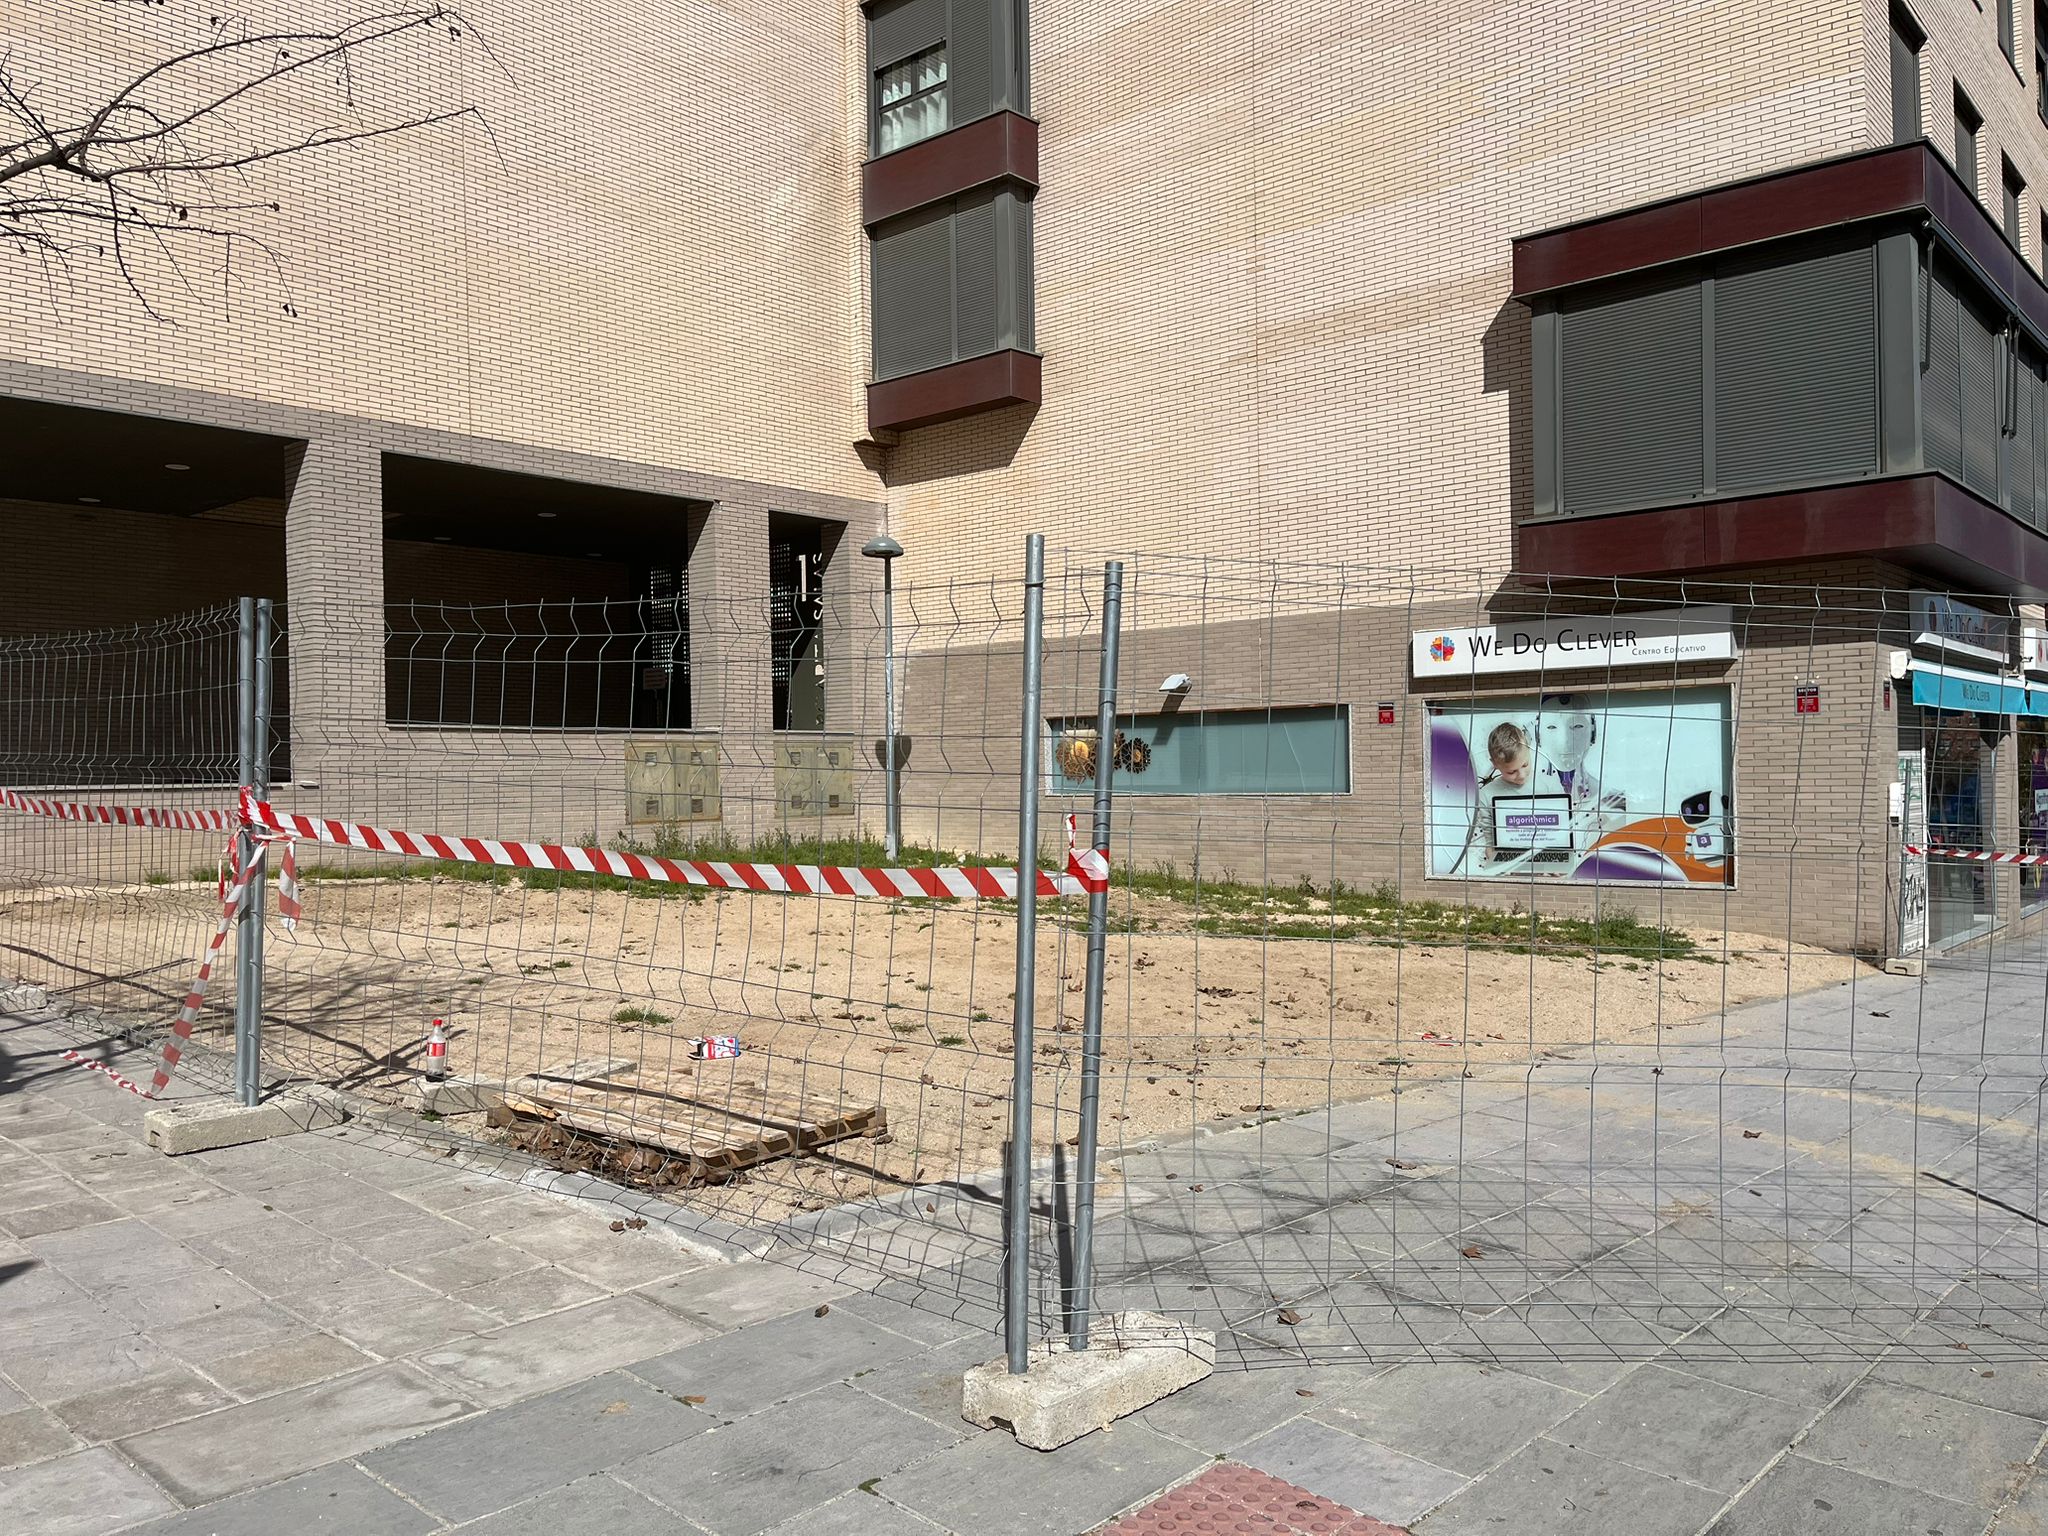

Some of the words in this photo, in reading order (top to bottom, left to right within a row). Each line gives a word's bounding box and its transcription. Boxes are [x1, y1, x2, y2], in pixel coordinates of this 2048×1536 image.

[1468, 634, 1504, 658] WE
[1513, 632, 1547, 655] DO
[1557, 628, 1637, 652] CLEVER
[1631, 647, 1661, 656] CENTRO
[1508, 815, 1556, 825] algorithmics
[1700, 836, 1708, 844] a
